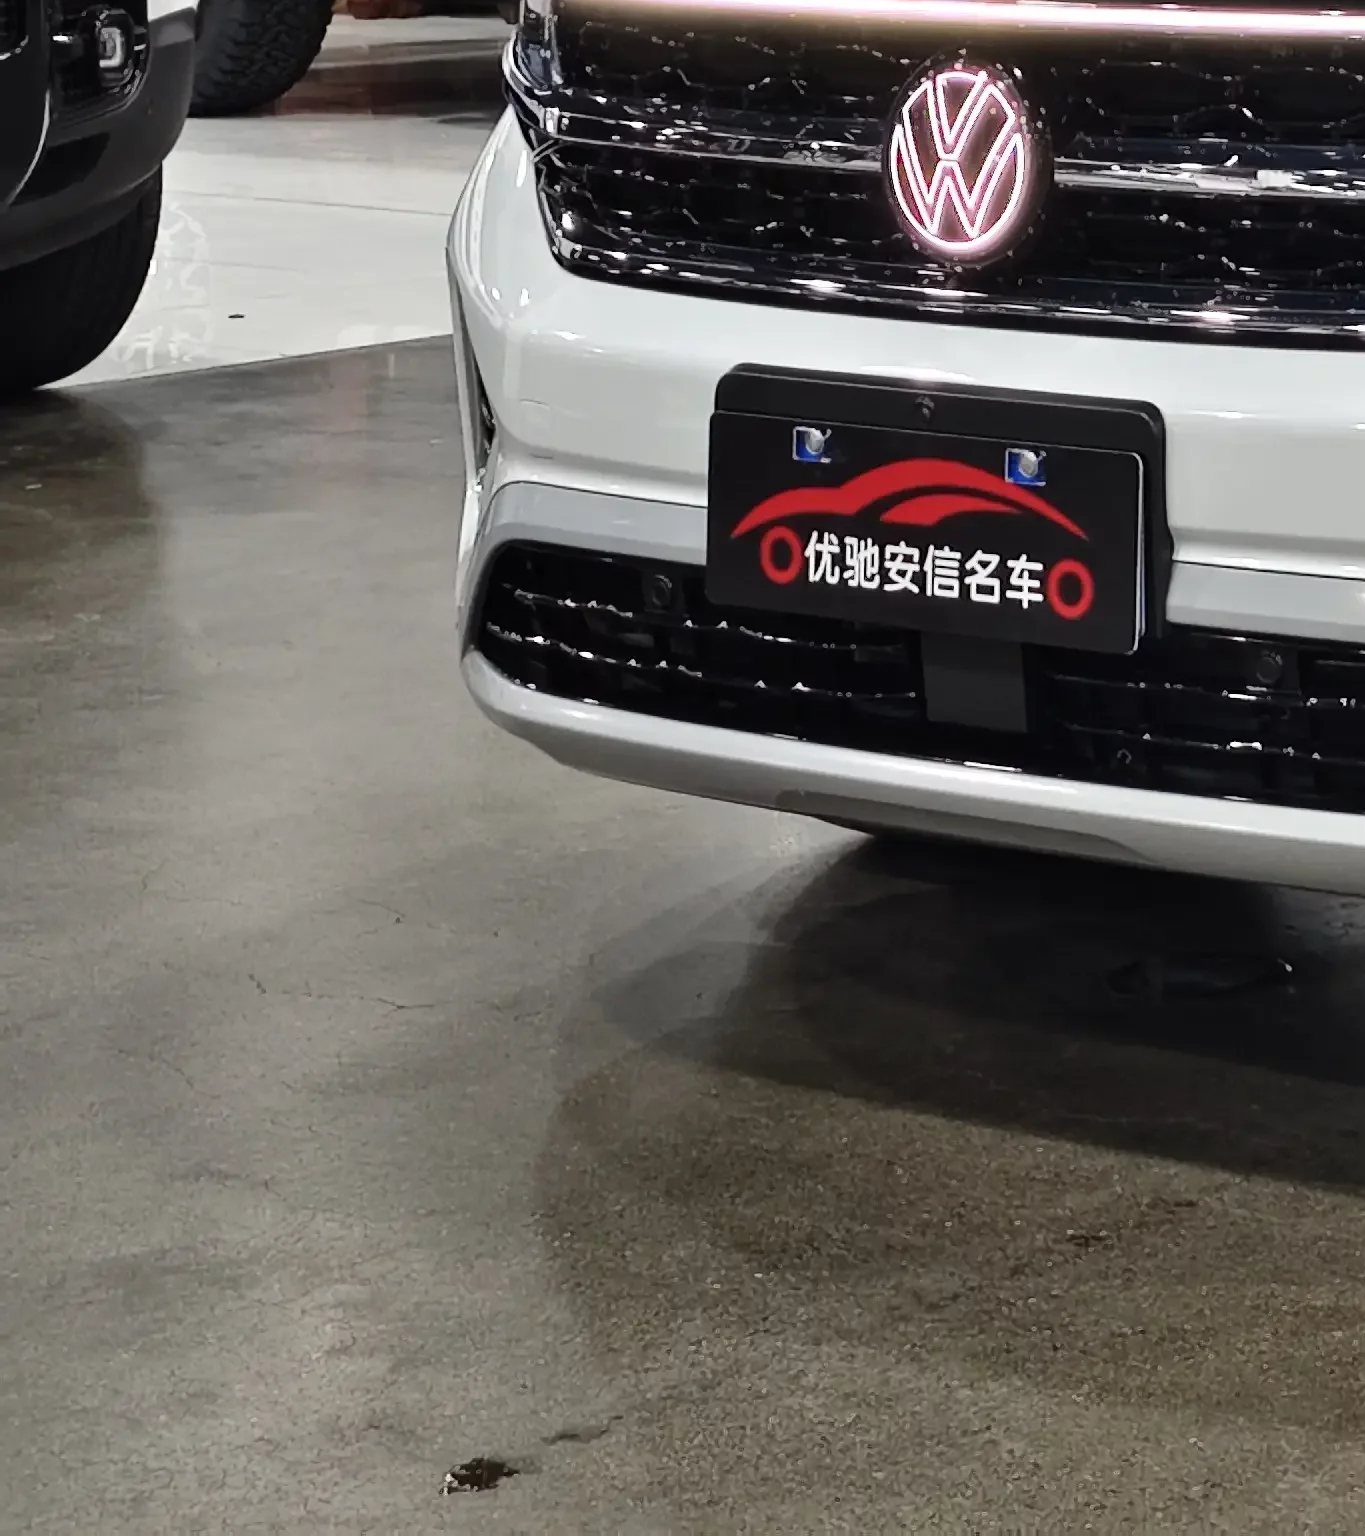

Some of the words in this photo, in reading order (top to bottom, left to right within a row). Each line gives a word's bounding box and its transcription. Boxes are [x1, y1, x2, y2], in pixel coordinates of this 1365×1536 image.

[804, 530, 1045, 610] 优驰安信名车
